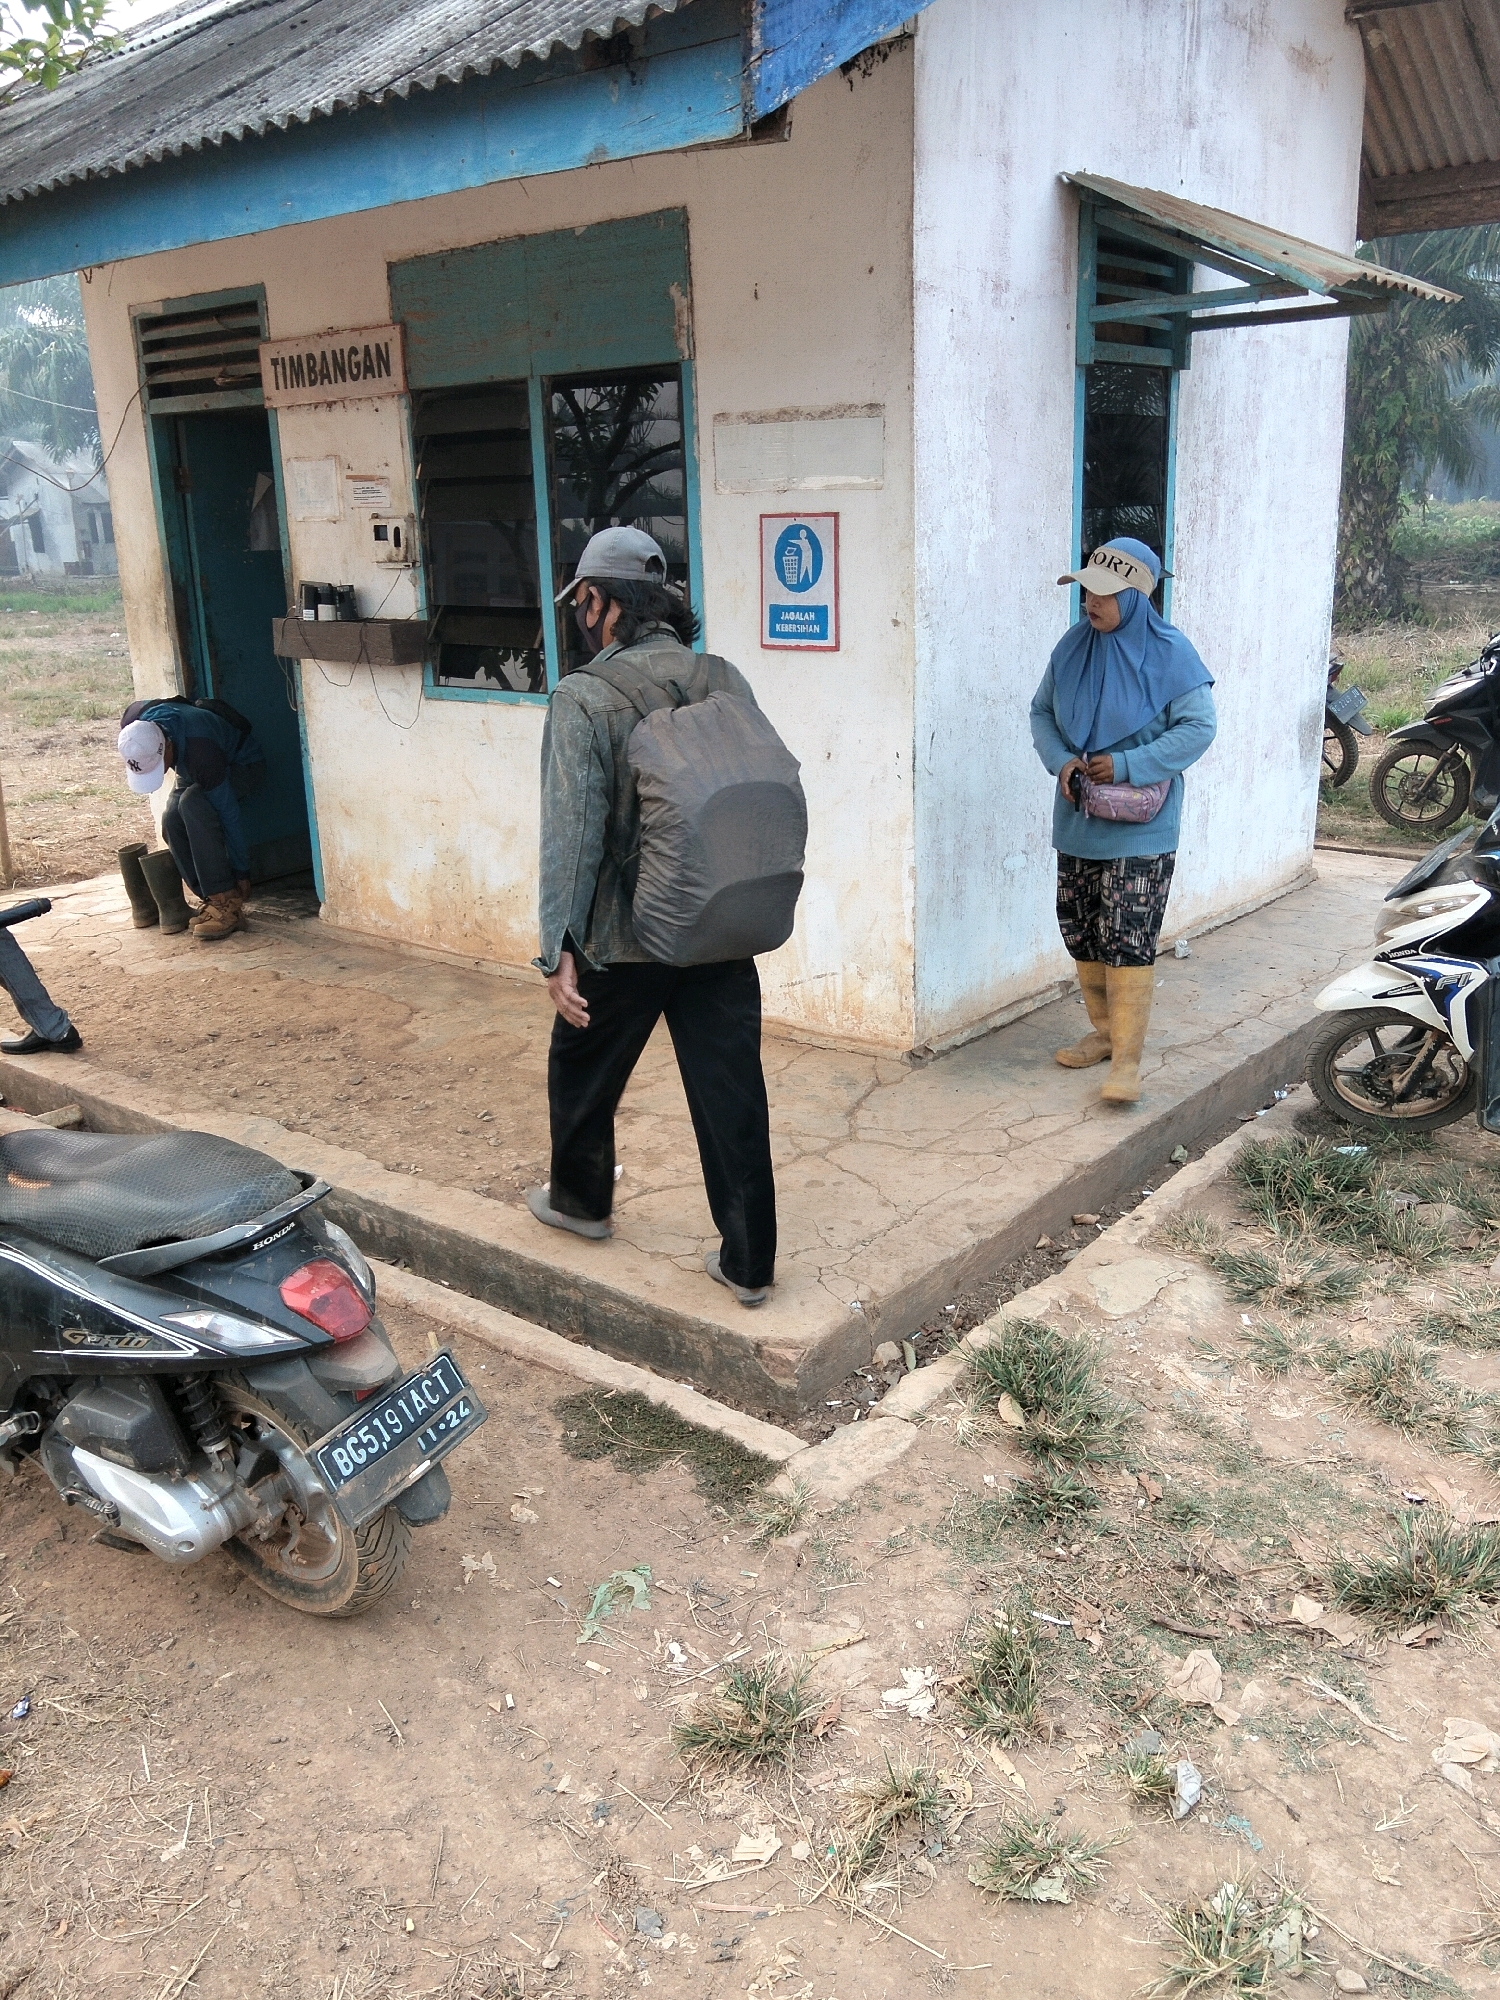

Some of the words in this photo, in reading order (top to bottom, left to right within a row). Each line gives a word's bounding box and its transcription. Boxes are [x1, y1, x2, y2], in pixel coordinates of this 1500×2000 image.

[270, 342, 391, 390] TIMBANGAN
[780, 611, 815, 621] JAGALAH
[775, 623, 820, 633] KEBERSIHAN
[1389, 948, 1417, 958] HONDA
[1435, 971, 1472, 991] FI
[252, 1221, 296, 1251] HONDA
